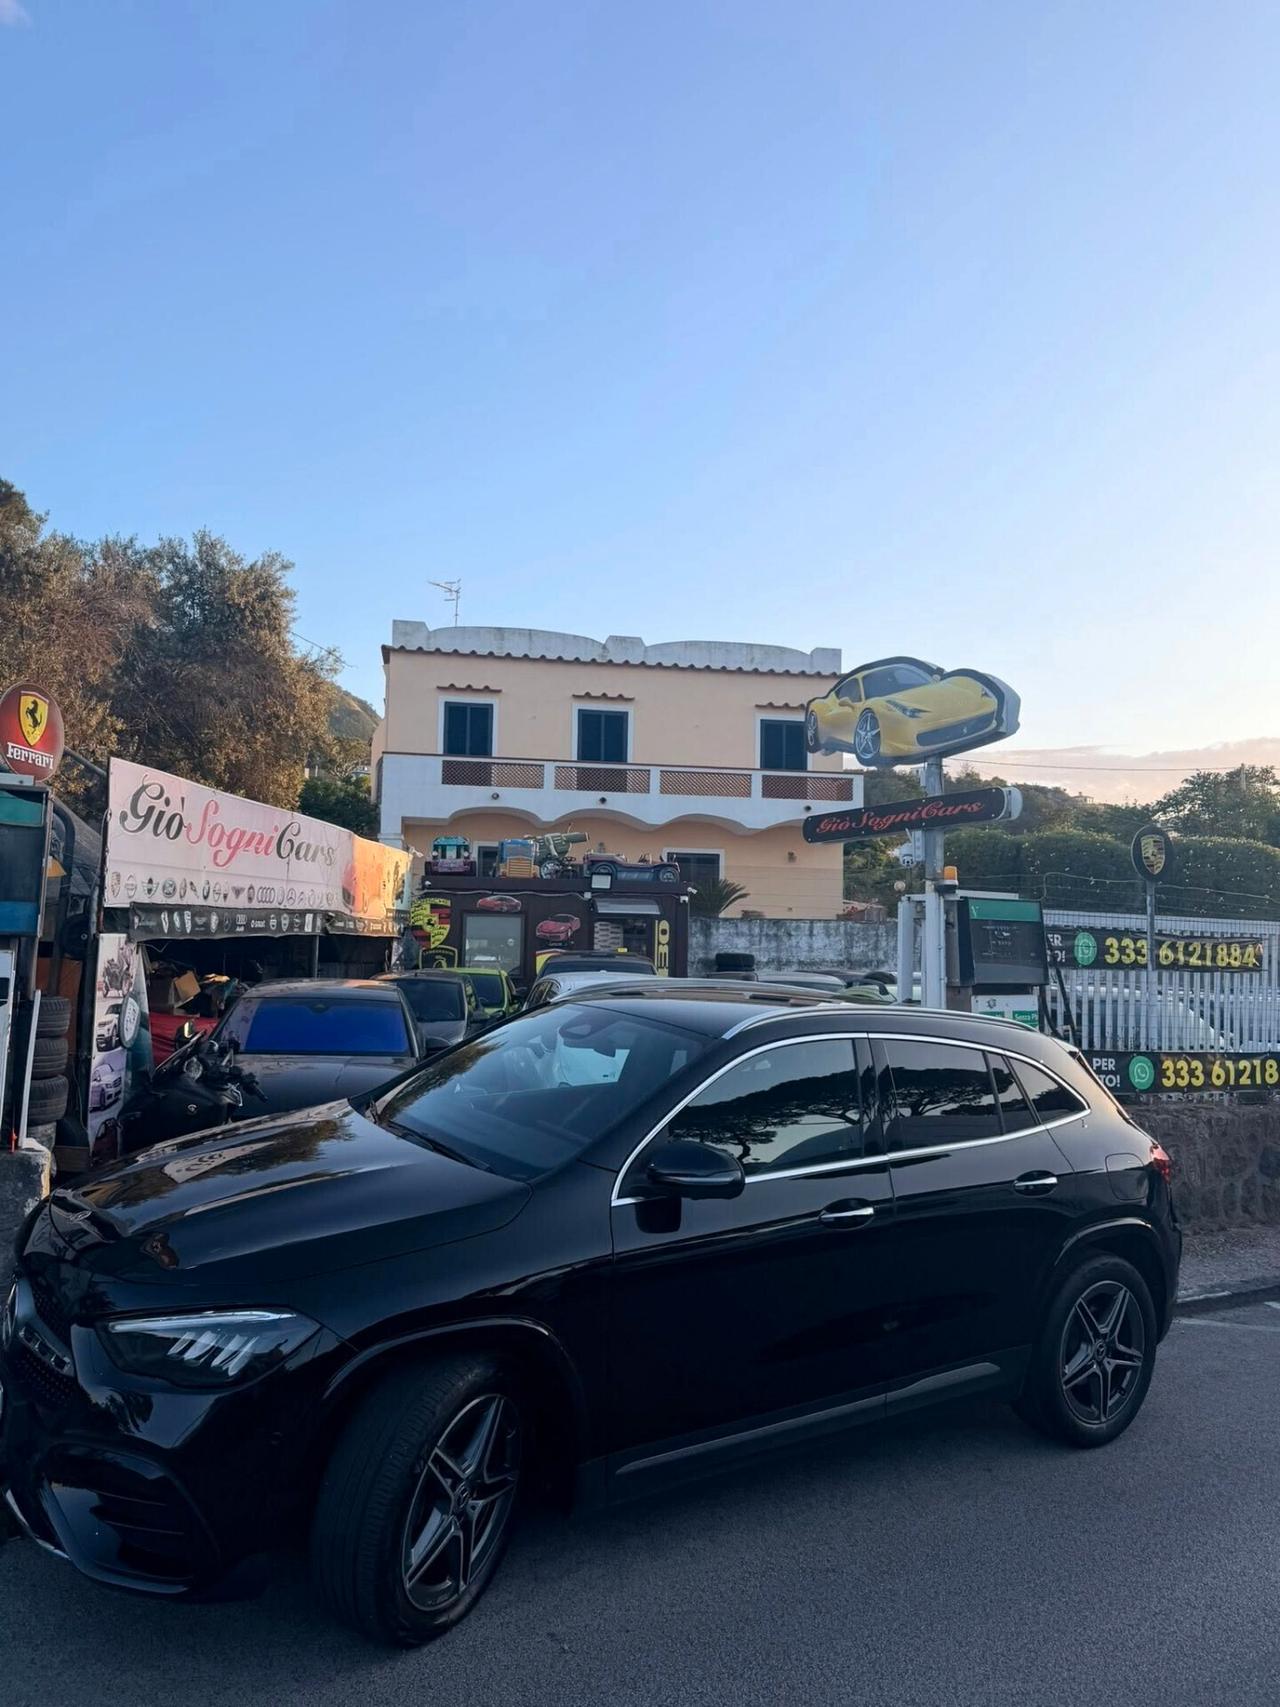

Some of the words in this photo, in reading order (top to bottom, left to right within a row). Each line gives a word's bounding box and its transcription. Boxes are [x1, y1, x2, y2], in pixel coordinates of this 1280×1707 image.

[7, 742, 54, 769] Ferrari
[1104, 936, 1149, 965] 333
[1158, 940, 1257, 969] 6121884
[1092, 1057, 1116, 1071] PER
[1162, 1060, 1205, 1088] 333
